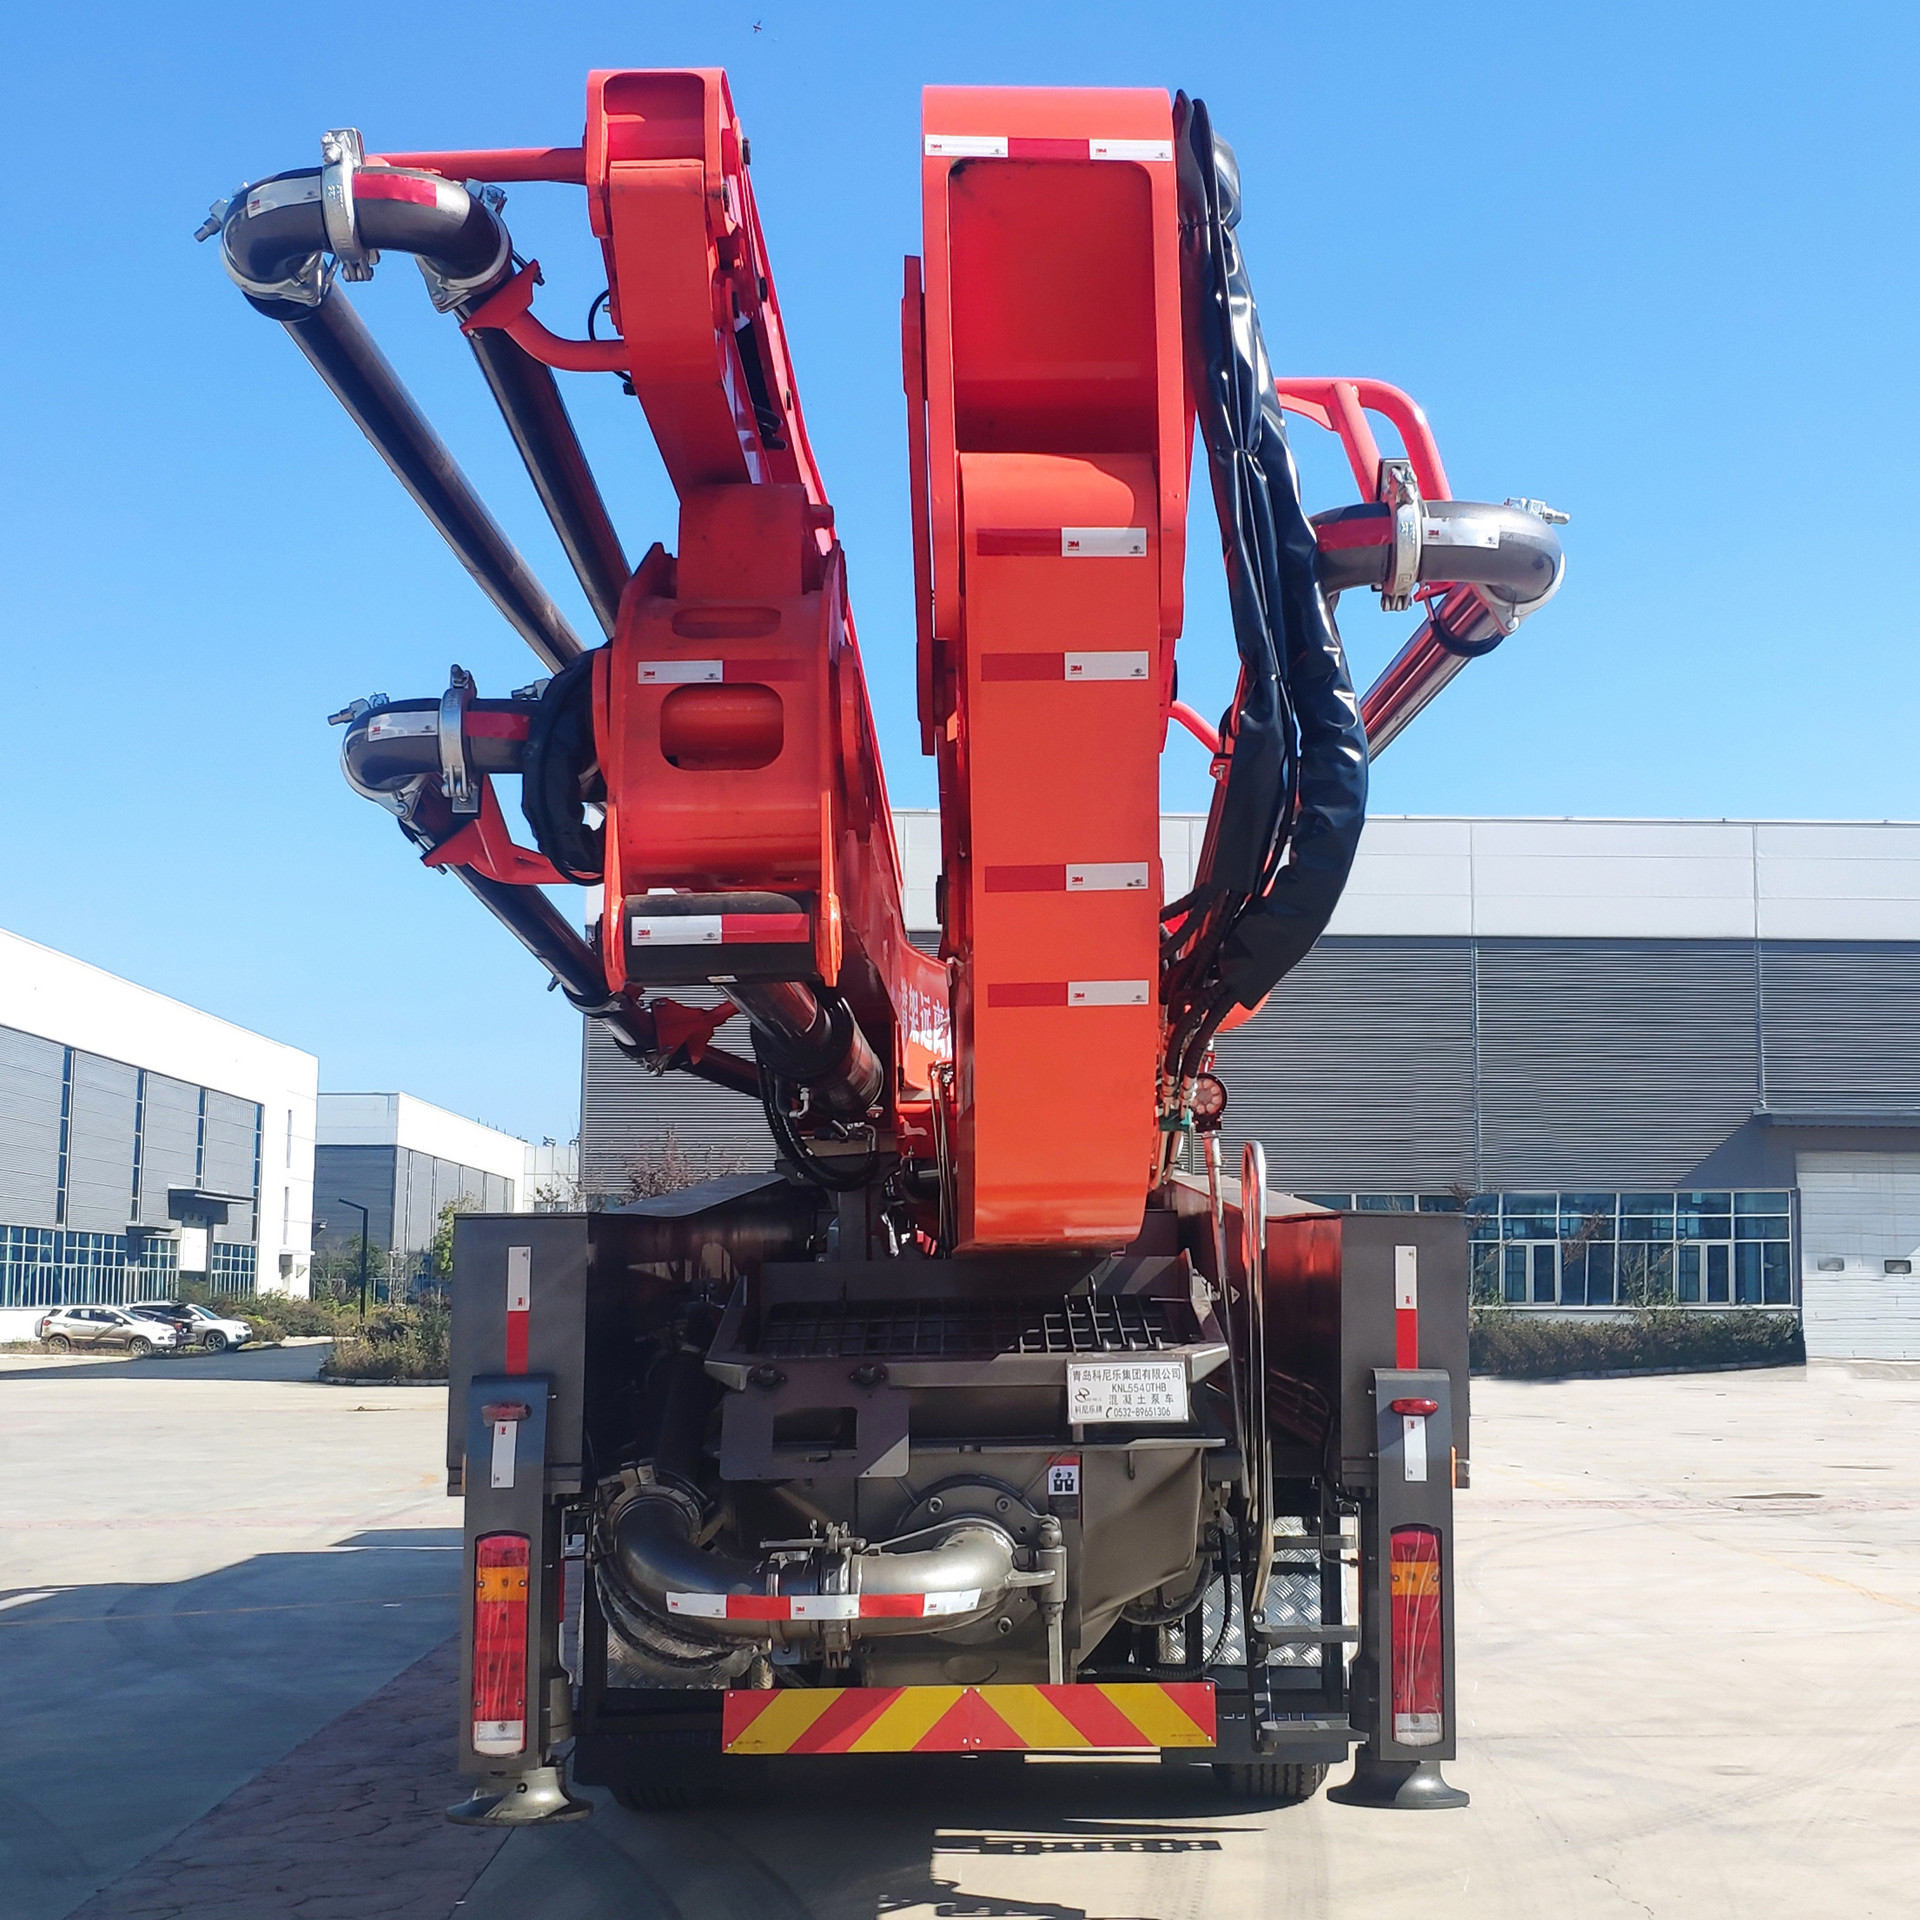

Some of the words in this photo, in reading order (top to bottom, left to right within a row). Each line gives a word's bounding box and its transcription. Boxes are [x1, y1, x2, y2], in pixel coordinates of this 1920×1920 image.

[1073, 1368, 1181, 1381] 青岛科尼乐集团有限公司
[1112, 1383, 1166, 1393] KNL5540THB
[1109, 1394, 1174, 1405] 混凝土泵车
[1113, 1407, 1171, 1417] 0532-89651306
